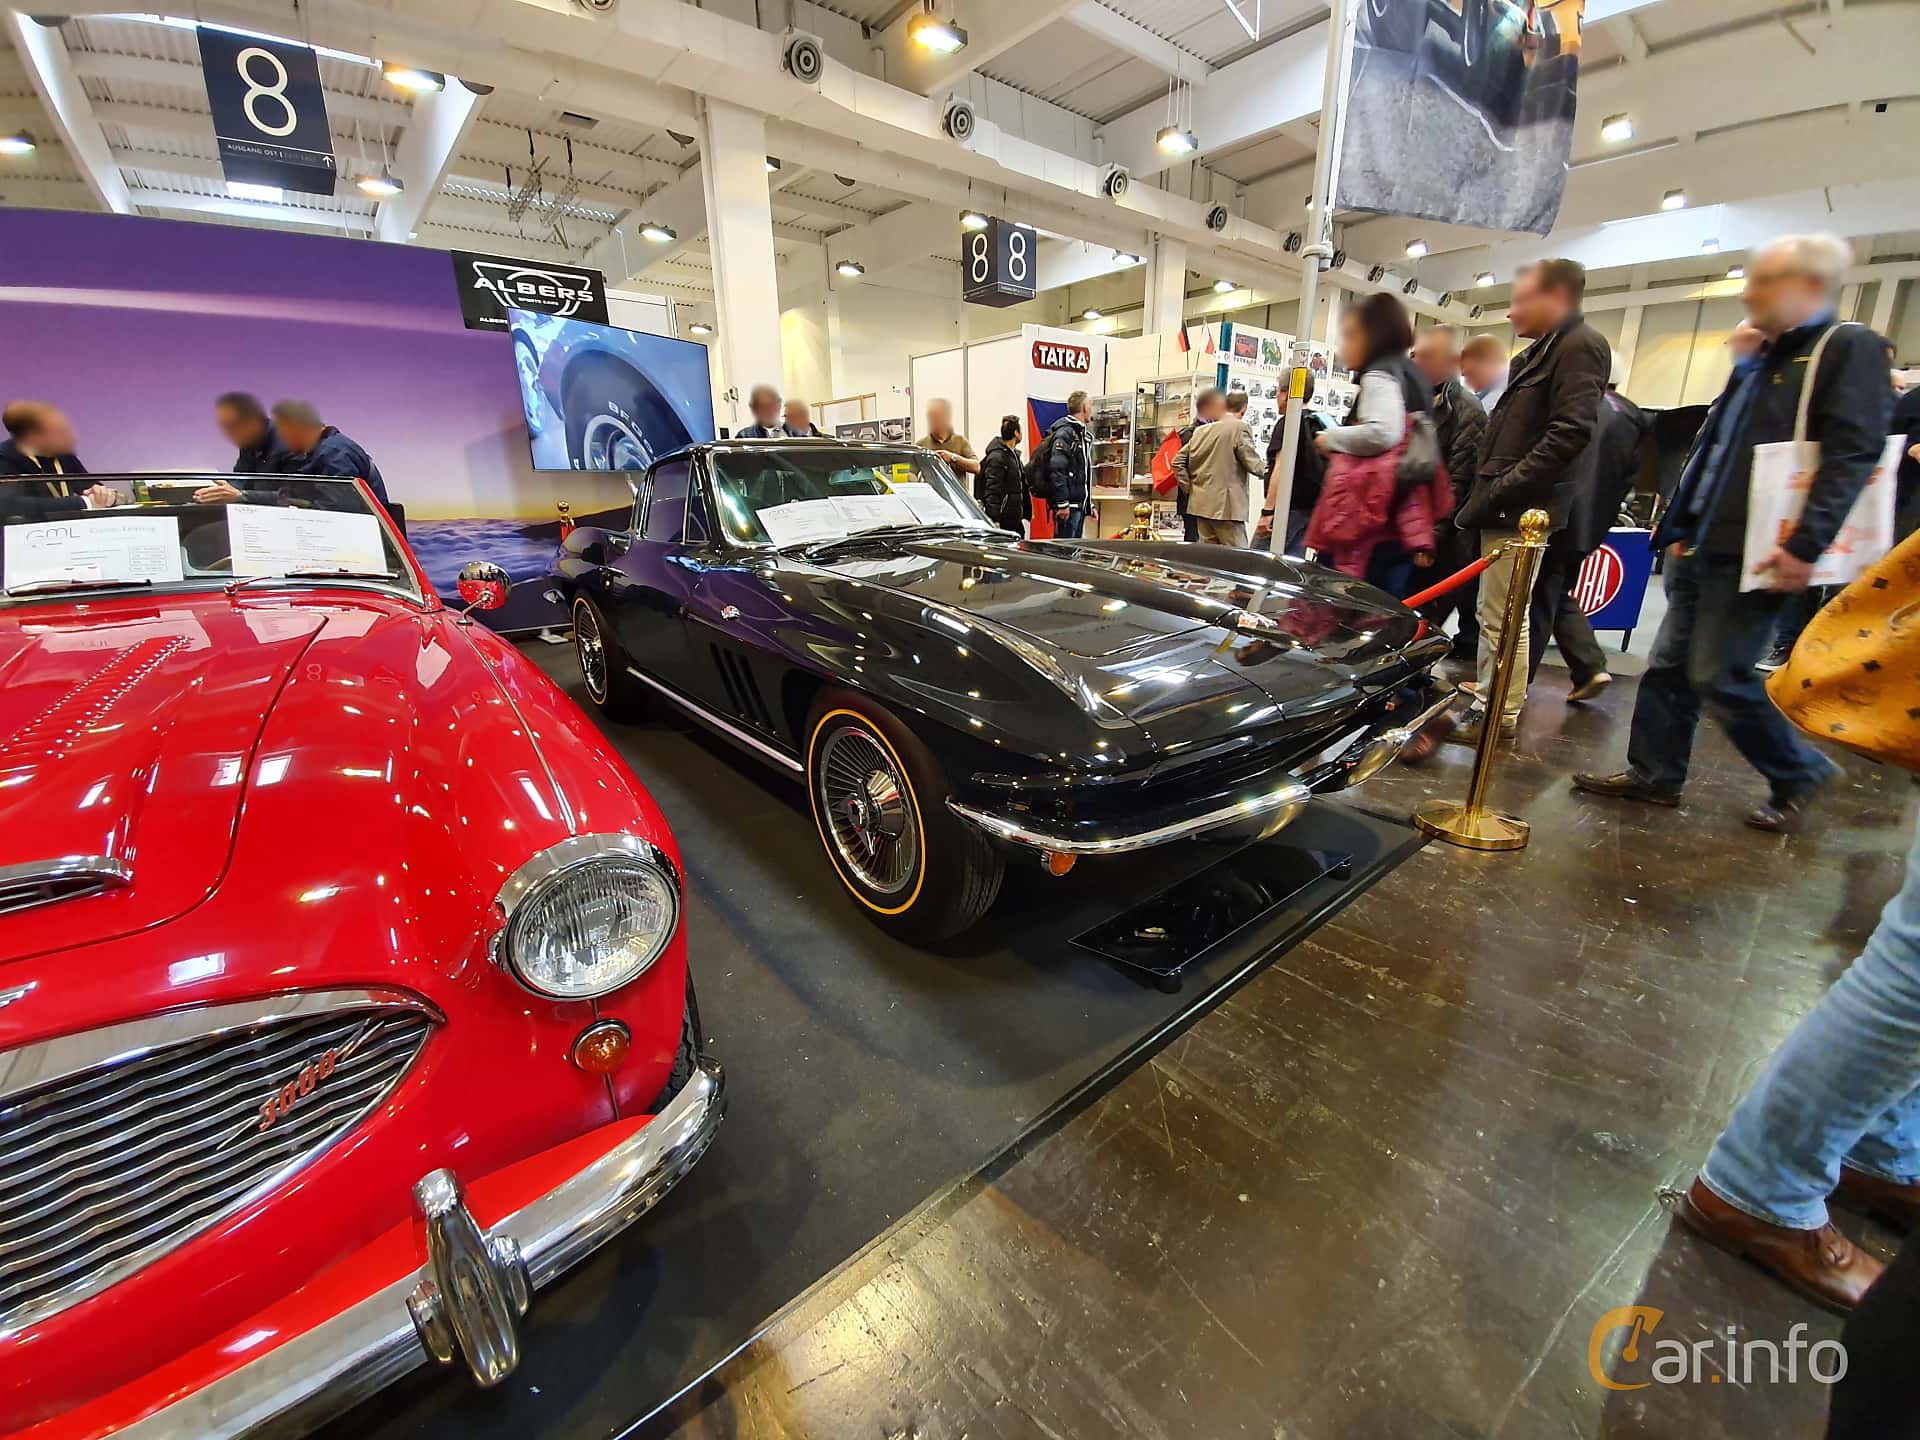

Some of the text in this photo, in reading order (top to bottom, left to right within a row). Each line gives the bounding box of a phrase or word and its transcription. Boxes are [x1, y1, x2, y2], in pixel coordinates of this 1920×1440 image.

[237, 47, 297, 136] 8
[972, 233, 988, 282] 8
[1009, 231, 1026, 281] 8
[474, 277, 593, 302] ALBERS
[1039, 345, 1088, 370] TATRA
[259, 1047, 335, 1131] 3000
